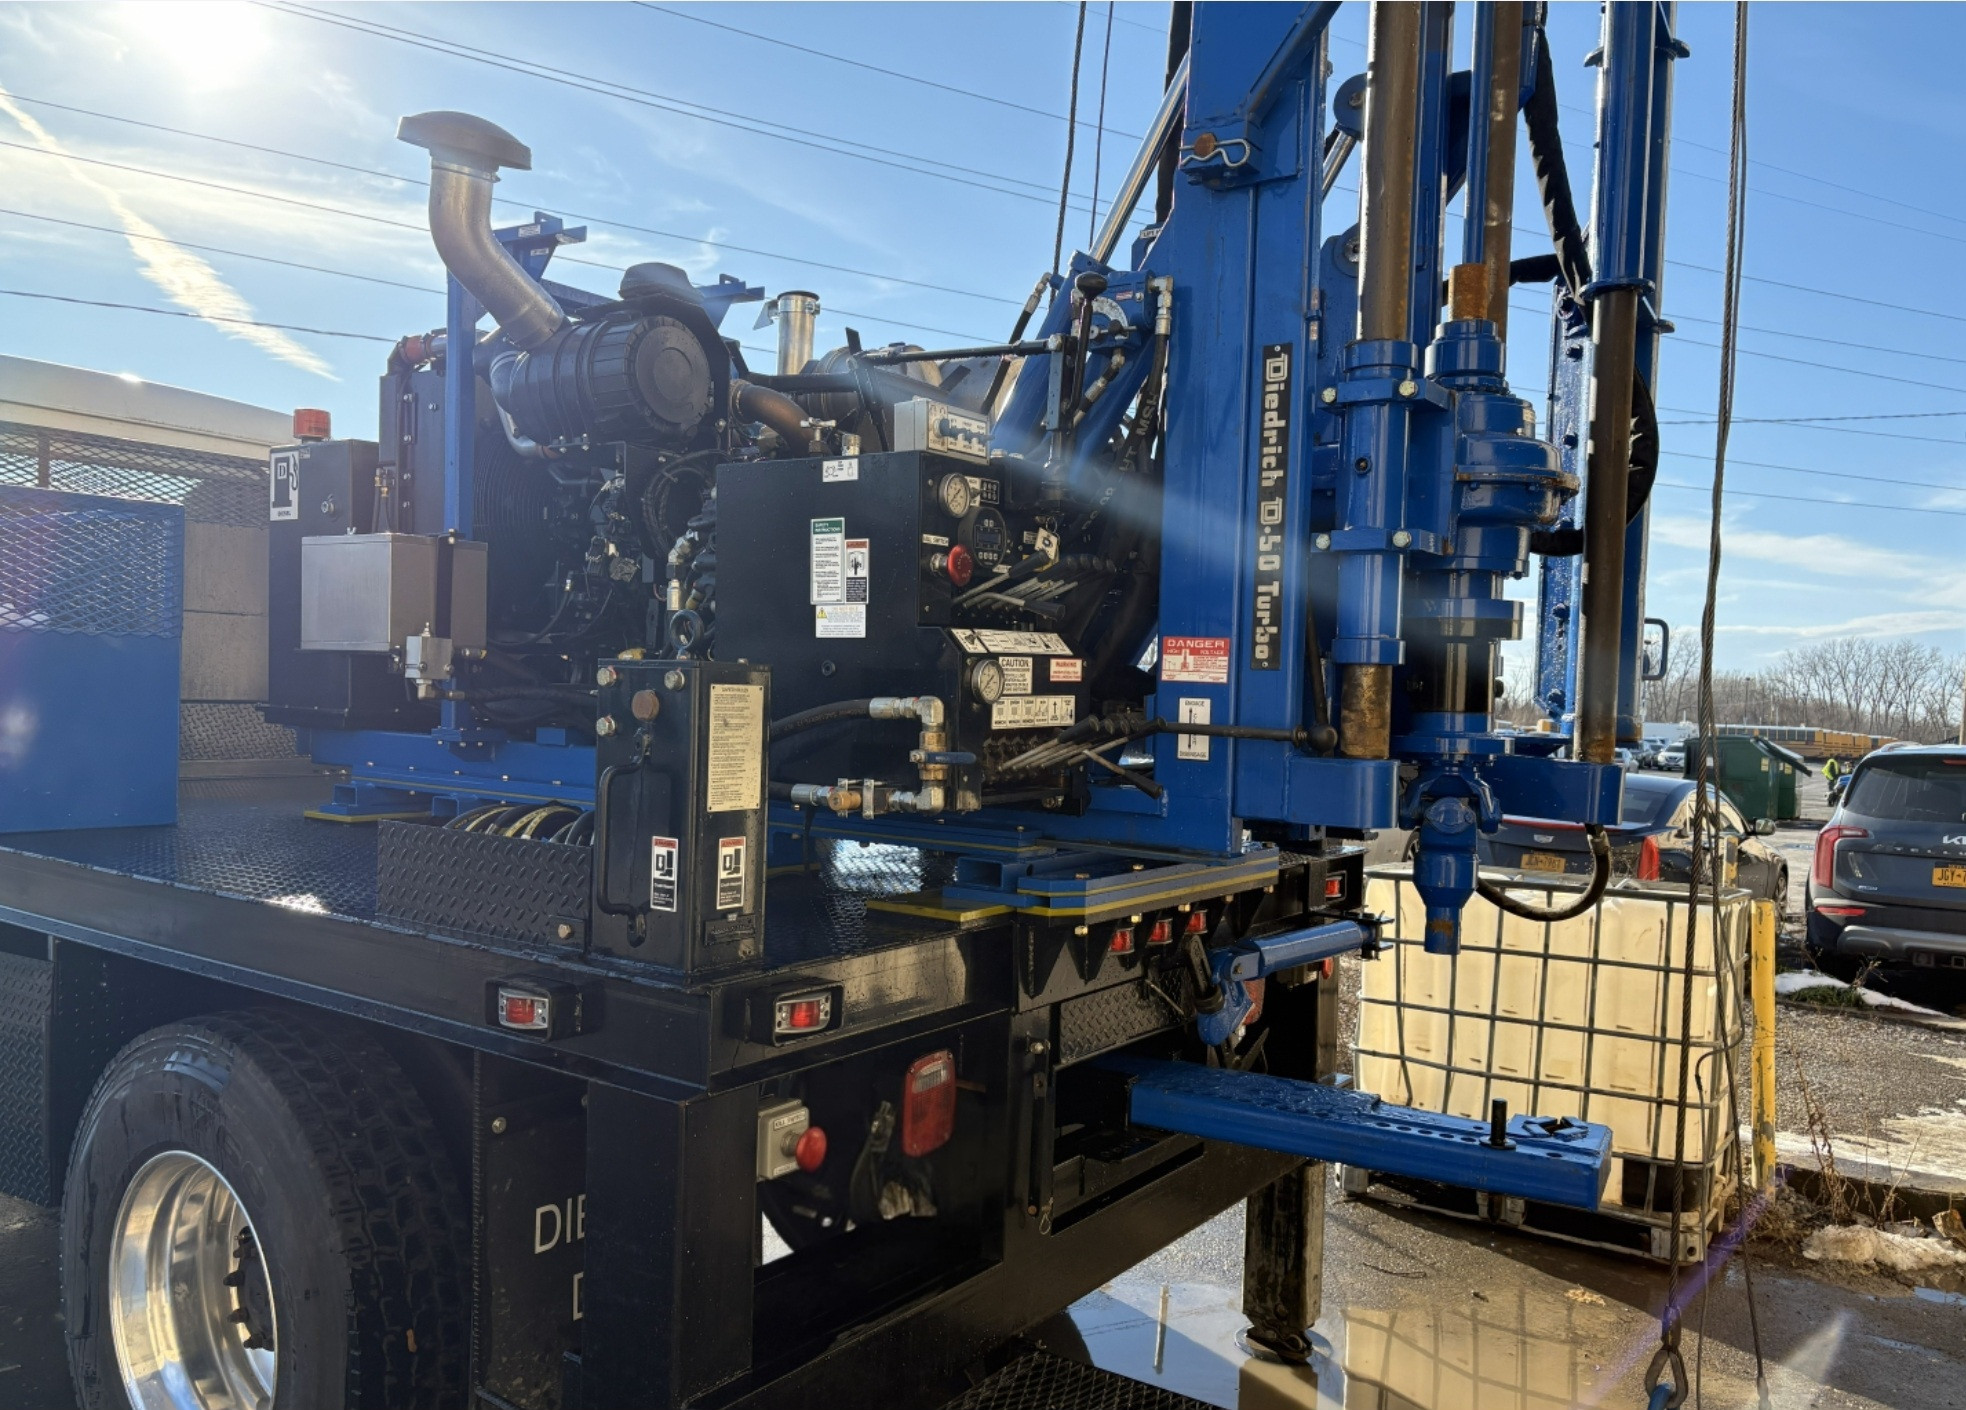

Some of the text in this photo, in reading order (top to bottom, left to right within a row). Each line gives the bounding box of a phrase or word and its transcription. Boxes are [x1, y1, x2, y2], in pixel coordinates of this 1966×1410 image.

[1262, 353, 1288, 487] Diedrich
[1254, 580, 1280, 660] Turbo
[1001, 659, 1029, 667] CAUTION
[1167, 639, 1225, 648] DANGER
